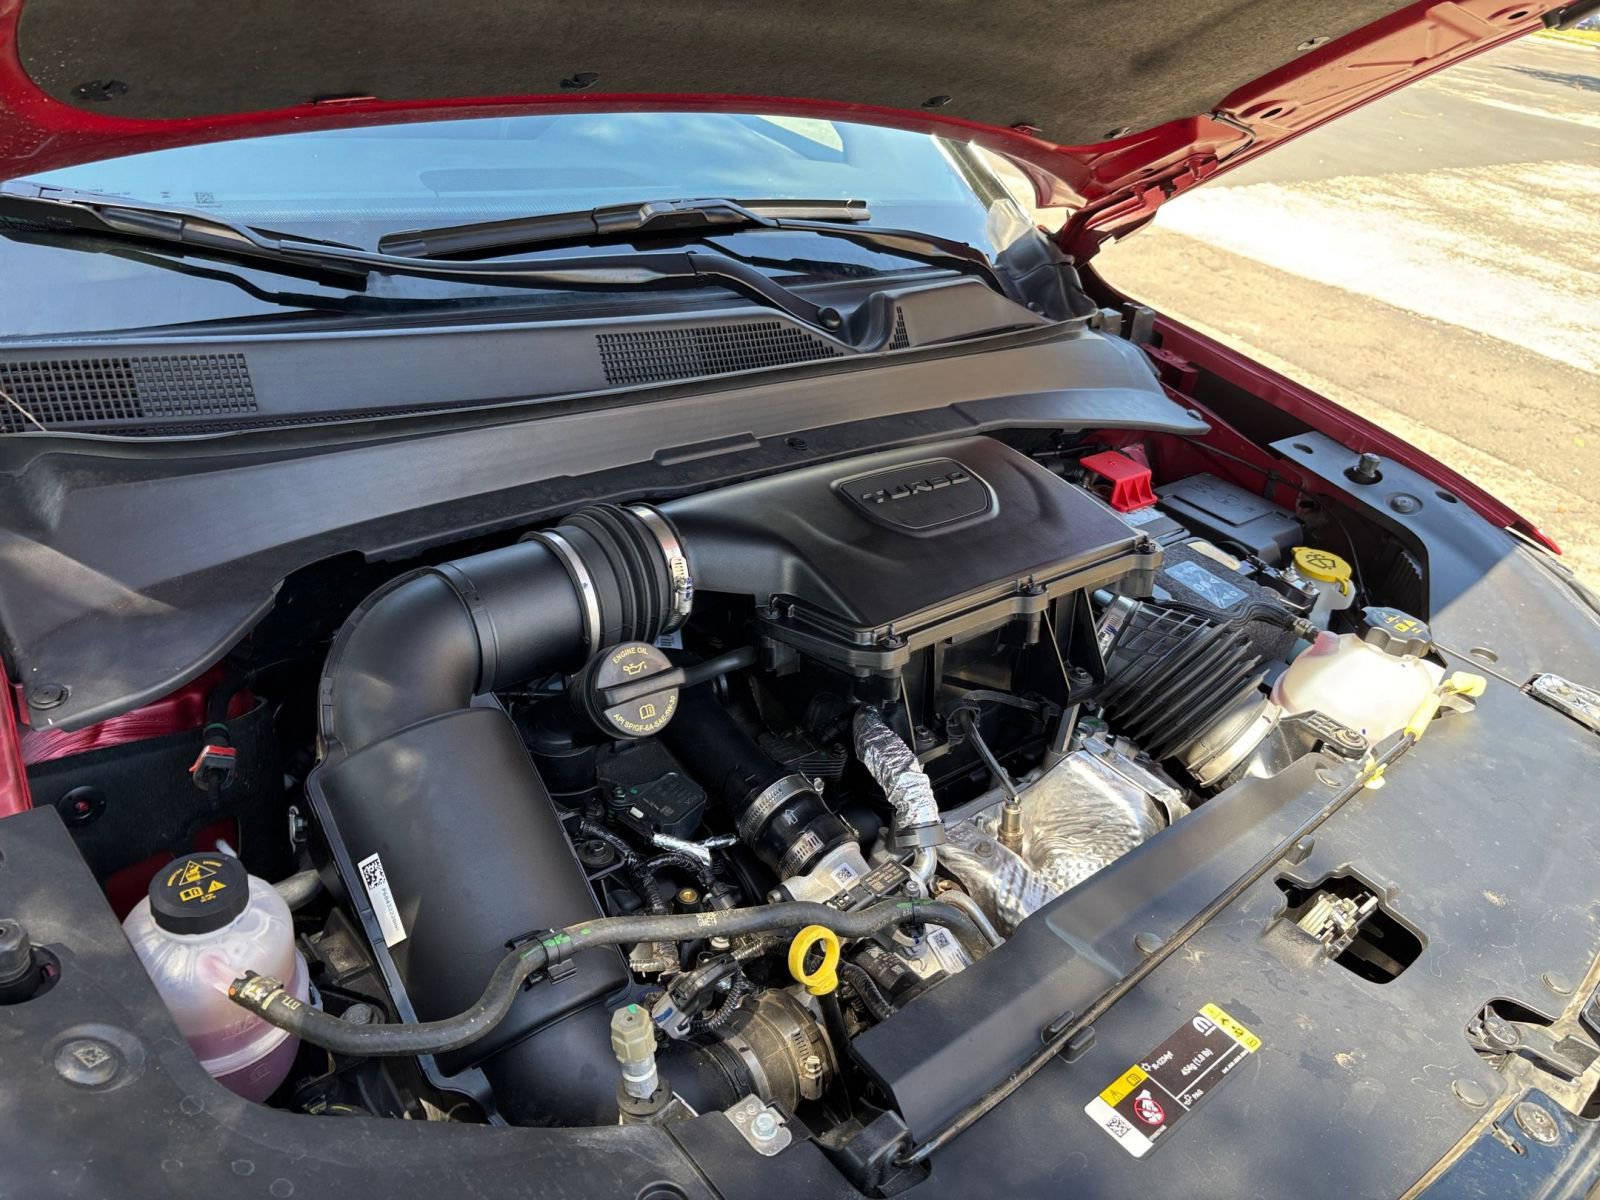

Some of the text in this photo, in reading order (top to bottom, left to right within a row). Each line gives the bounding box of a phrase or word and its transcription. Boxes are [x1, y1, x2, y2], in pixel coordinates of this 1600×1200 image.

[612, 647, 649, 663] ENGINE OIL
[613, 713, 625, 726] API
